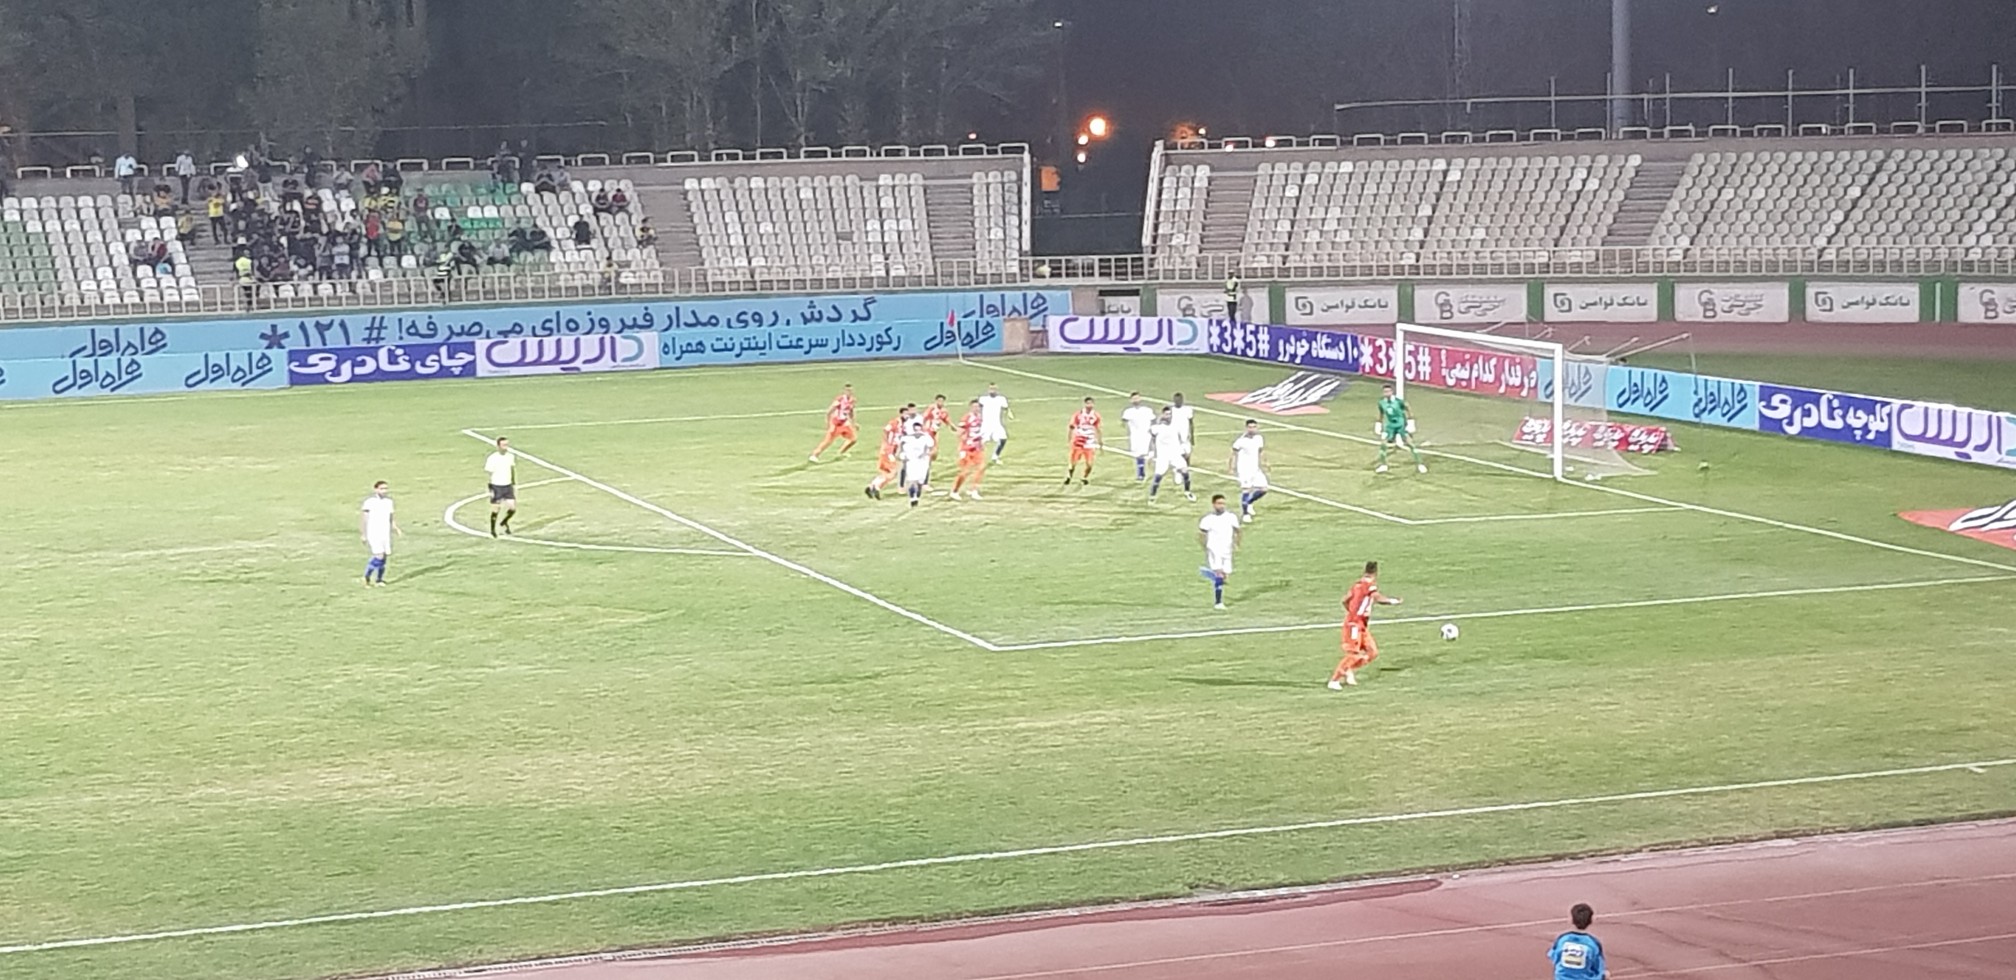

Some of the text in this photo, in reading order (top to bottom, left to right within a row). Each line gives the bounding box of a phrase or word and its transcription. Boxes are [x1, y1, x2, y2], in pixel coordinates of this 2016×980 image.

[660, 305, 720, 333] مدار
[726, 308, 780, 330] روی
[786, 296, 877, 327] گردش
[661, 326, 901, 361] رکورددار سرعت اینترنت همراه
[1277, 330, 1310, 364] خودرو
[1310, 332, 1346, 361] دستگاه
[289, 344, 475, 383] چای نادری
[1758, 392, 1892, 441] کلوچه نادری
